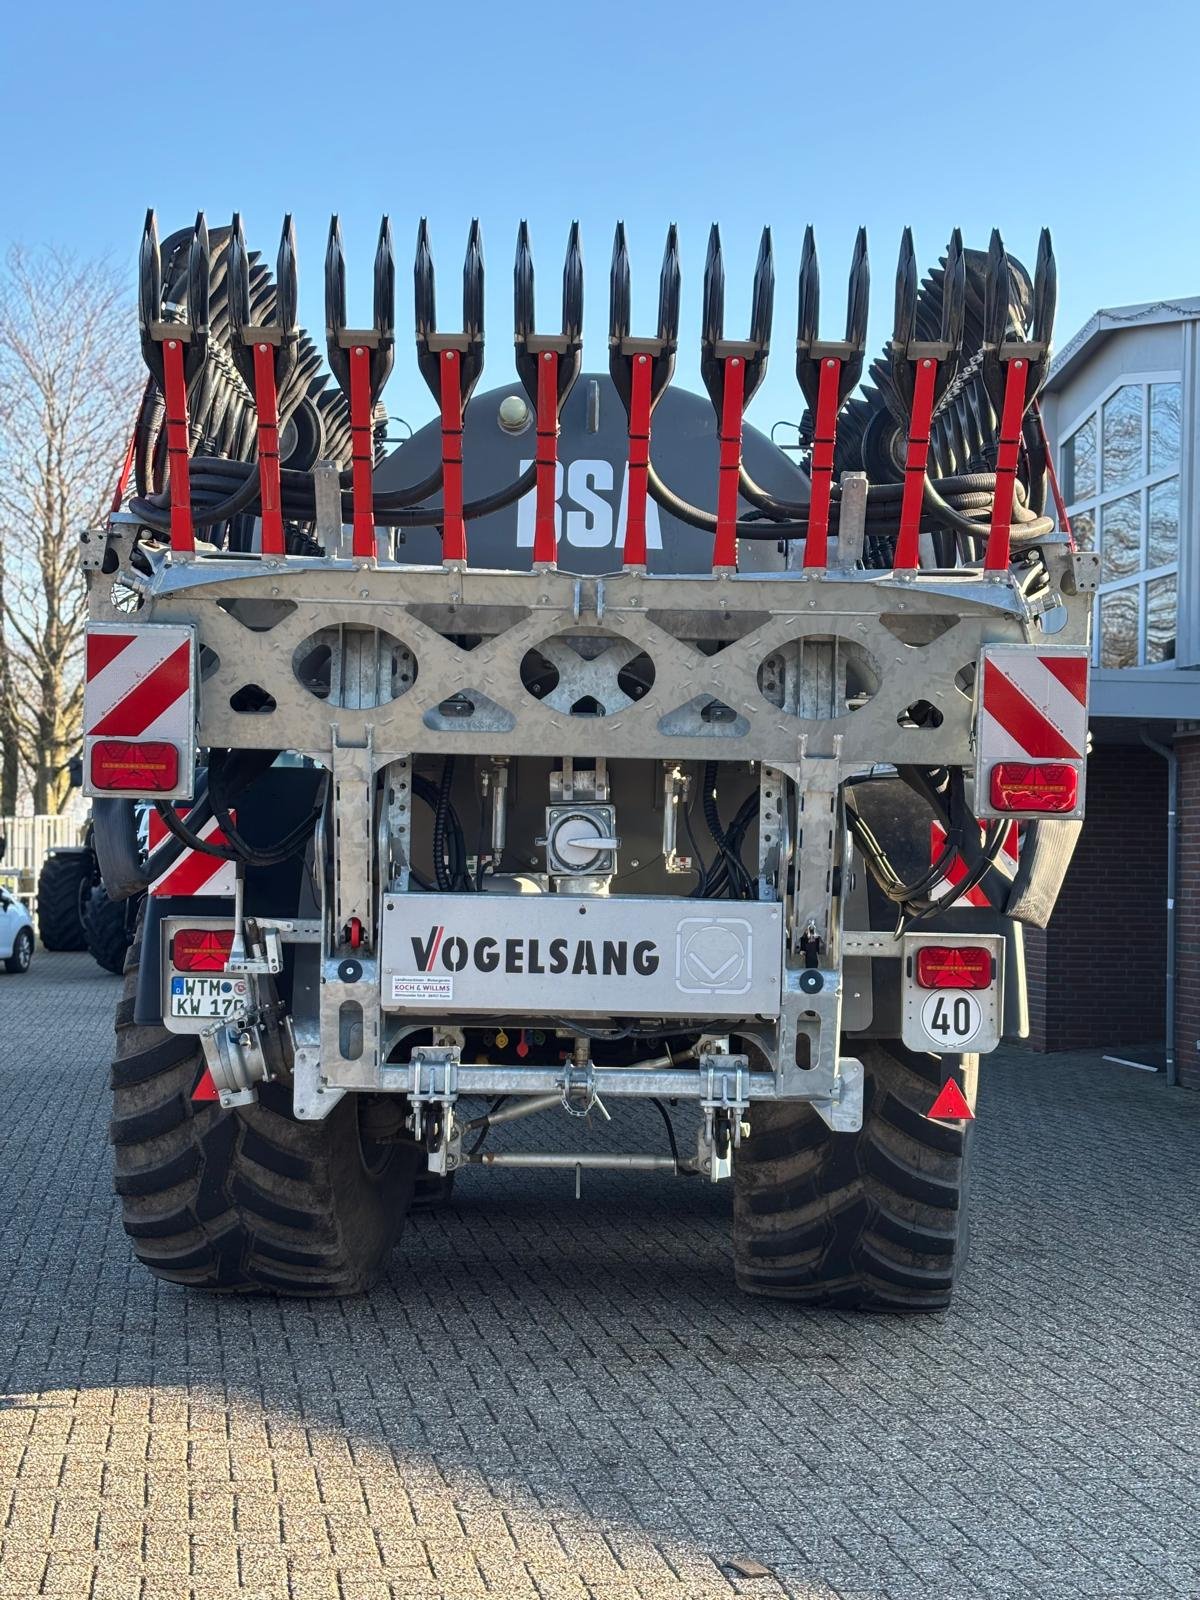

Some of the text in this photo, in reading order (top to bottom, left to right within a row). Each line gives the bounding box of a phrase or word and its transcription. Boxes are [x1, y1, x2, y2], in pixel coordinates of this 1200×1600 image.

[517, 459, 663, 549] BSA
[410, 926, 660, 976] VOGELSANG
[185, 979, 220, 996] WTM
[422, 984, 450, 992] WILLMS
[177, 998, 201, 1015] KW
[931, 997, 971, 1036] 40
